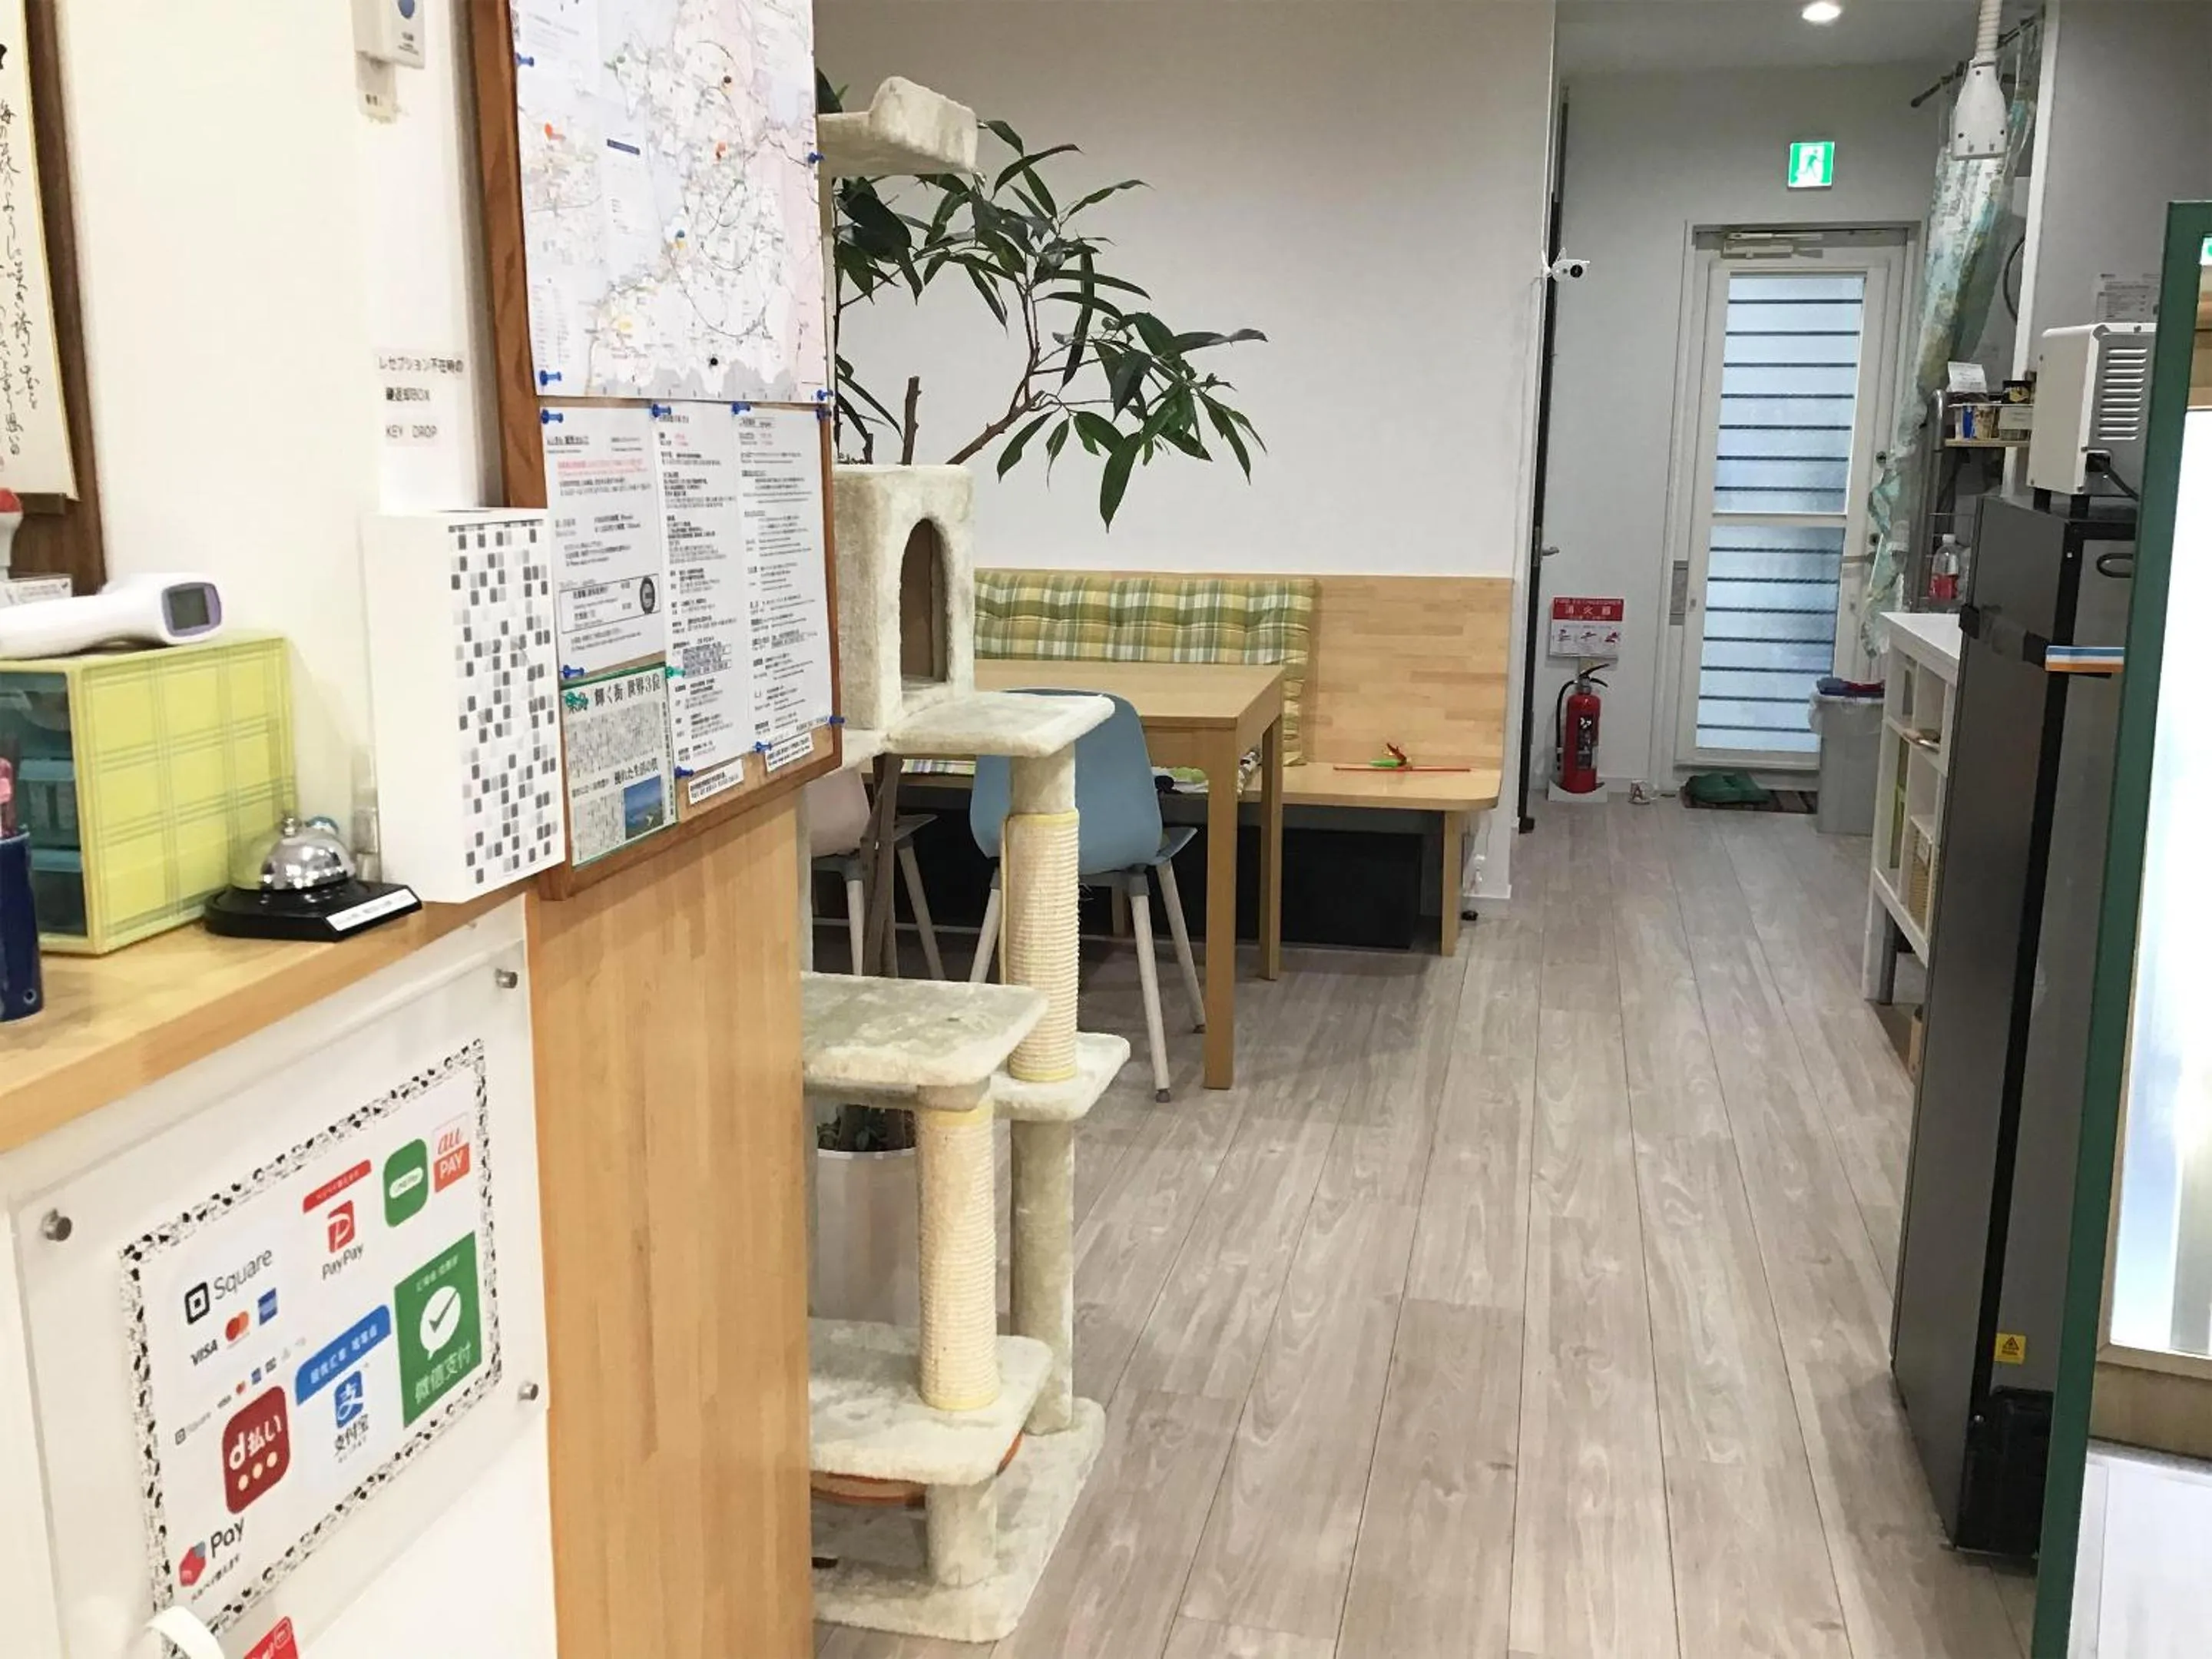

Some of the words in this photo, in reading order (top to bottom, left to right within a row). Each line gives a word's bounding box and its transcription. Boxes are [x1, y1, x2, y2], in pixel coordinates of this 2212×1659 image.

[386, 424, 402, 438] KEY
[412, 424, 437, 438] DROP
[438, 1127, 462, 1155] au
[439, 1149, 462, 1180] PAY
[214, 1250, 273, 1300] Square
[322, 1243, 364, 1280] PayPay
[190, 1339, 218, 1366] VISA
[415, 1339, 472, 1406] 微信支付
[229, 1415, 282, 1471] d払い
[210, 1517, 244, 1558] Pay
